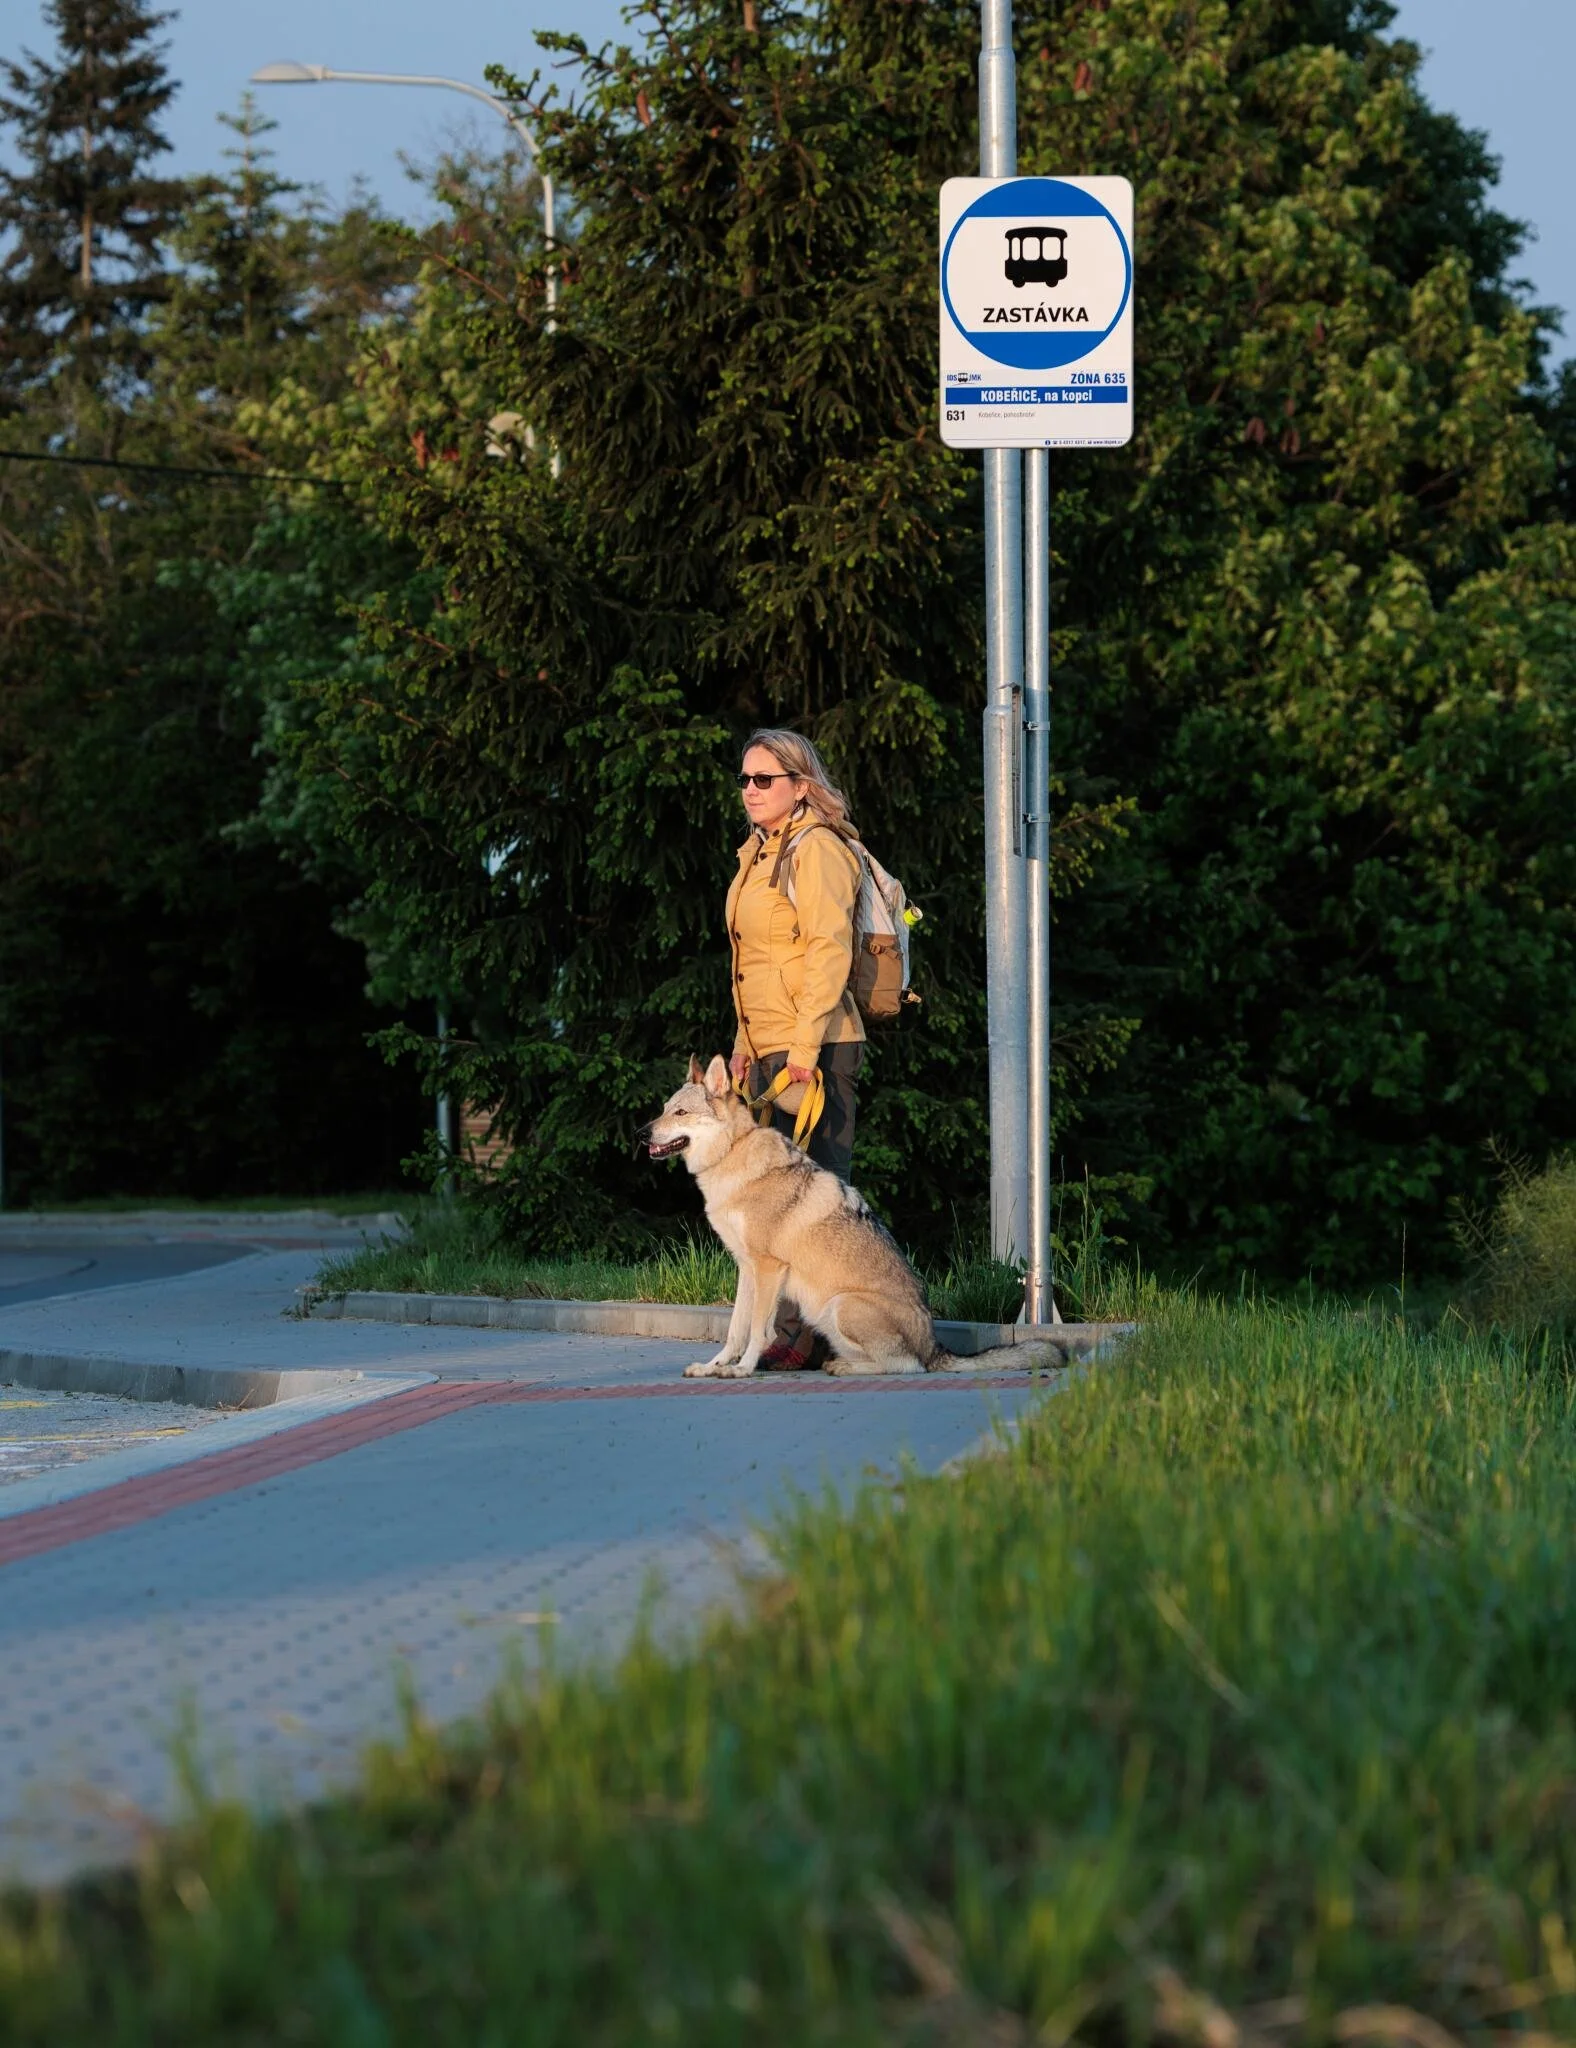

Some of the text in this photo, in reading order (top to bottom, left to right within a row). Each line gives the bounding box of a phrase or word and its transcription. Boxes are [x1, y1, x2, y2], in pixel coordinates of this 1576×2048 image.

[983, 302, 1089, 323] ZASTÁVKA
[1070, 371, 1126, 384] ZÓNA 635
[981, 388, 1092, 403] KOBEŘICE, na kopci
[946, 410, 966, 421] 631
